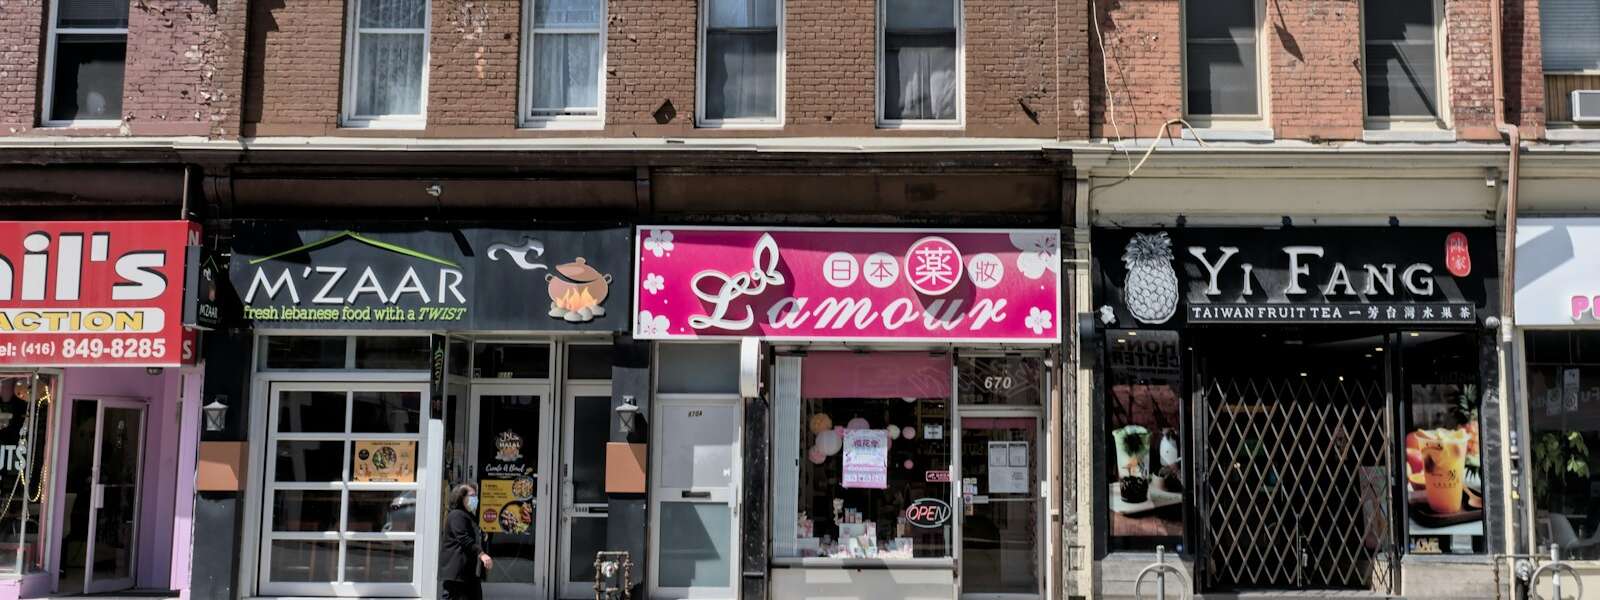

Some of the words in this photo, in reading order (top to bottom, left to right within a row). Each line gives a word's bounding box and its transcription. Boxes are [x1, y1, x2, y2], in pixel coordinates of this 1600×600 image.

[244, 265, 466, 304] M'ZAAR
[243, 305, 278, 320] fresh
[281, 305, 339, 321] lebanese
[341, 305, 371, 321] food
[374, 306, 405, 320] with
[407, 308, 415, 320] a
[418, 307, 467, 321] TWIST
[1192, 307, 1256, 318] TAIWAN
[1258, 307, 1305, 318] FRUIT
[1310, 307, 1342, 318] TEA
[21, 341, 56, 356] (416)
[62, 338, 166, 358] 849-8285
[984, 376, 1012, 389] 670
[909, 506, 946, 520] OPEN
